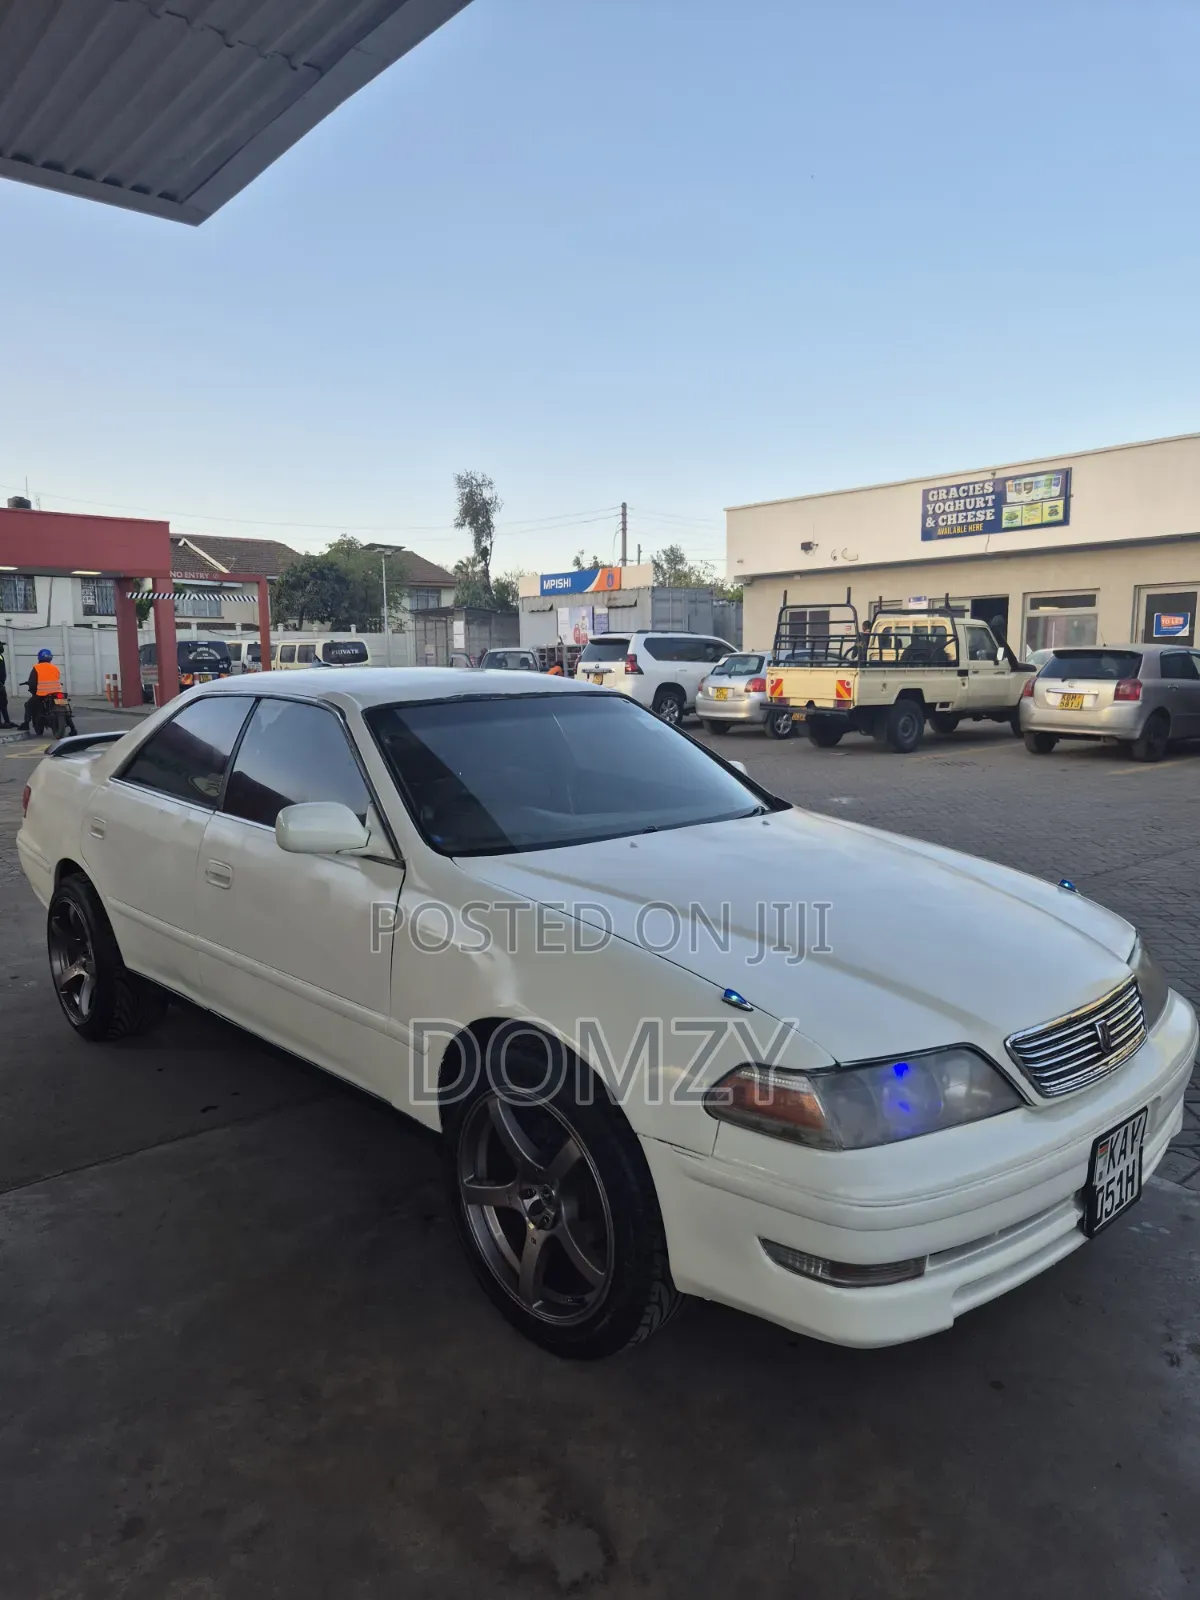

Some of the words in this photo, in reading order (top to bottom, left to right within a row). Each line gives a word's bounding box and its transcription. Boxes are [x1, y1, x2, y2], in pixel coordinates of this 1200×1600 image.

[929, 481, 993, 501] GRACIES
[926, 495, 995, 514] YOGHURT
[925, 516, 936, 528] &
[938, 509, 995, 526] CHEESE
[937, 525, 967, 535] AVAILABLE
[968, 523, 984, 532] HERE
[169, 570, 183, 578] NO
[184, 571, 209, 579] ENTRY
[543, 578, 571, 590] MPISHI
[1107, 1115, 1143, 1175] KAY
